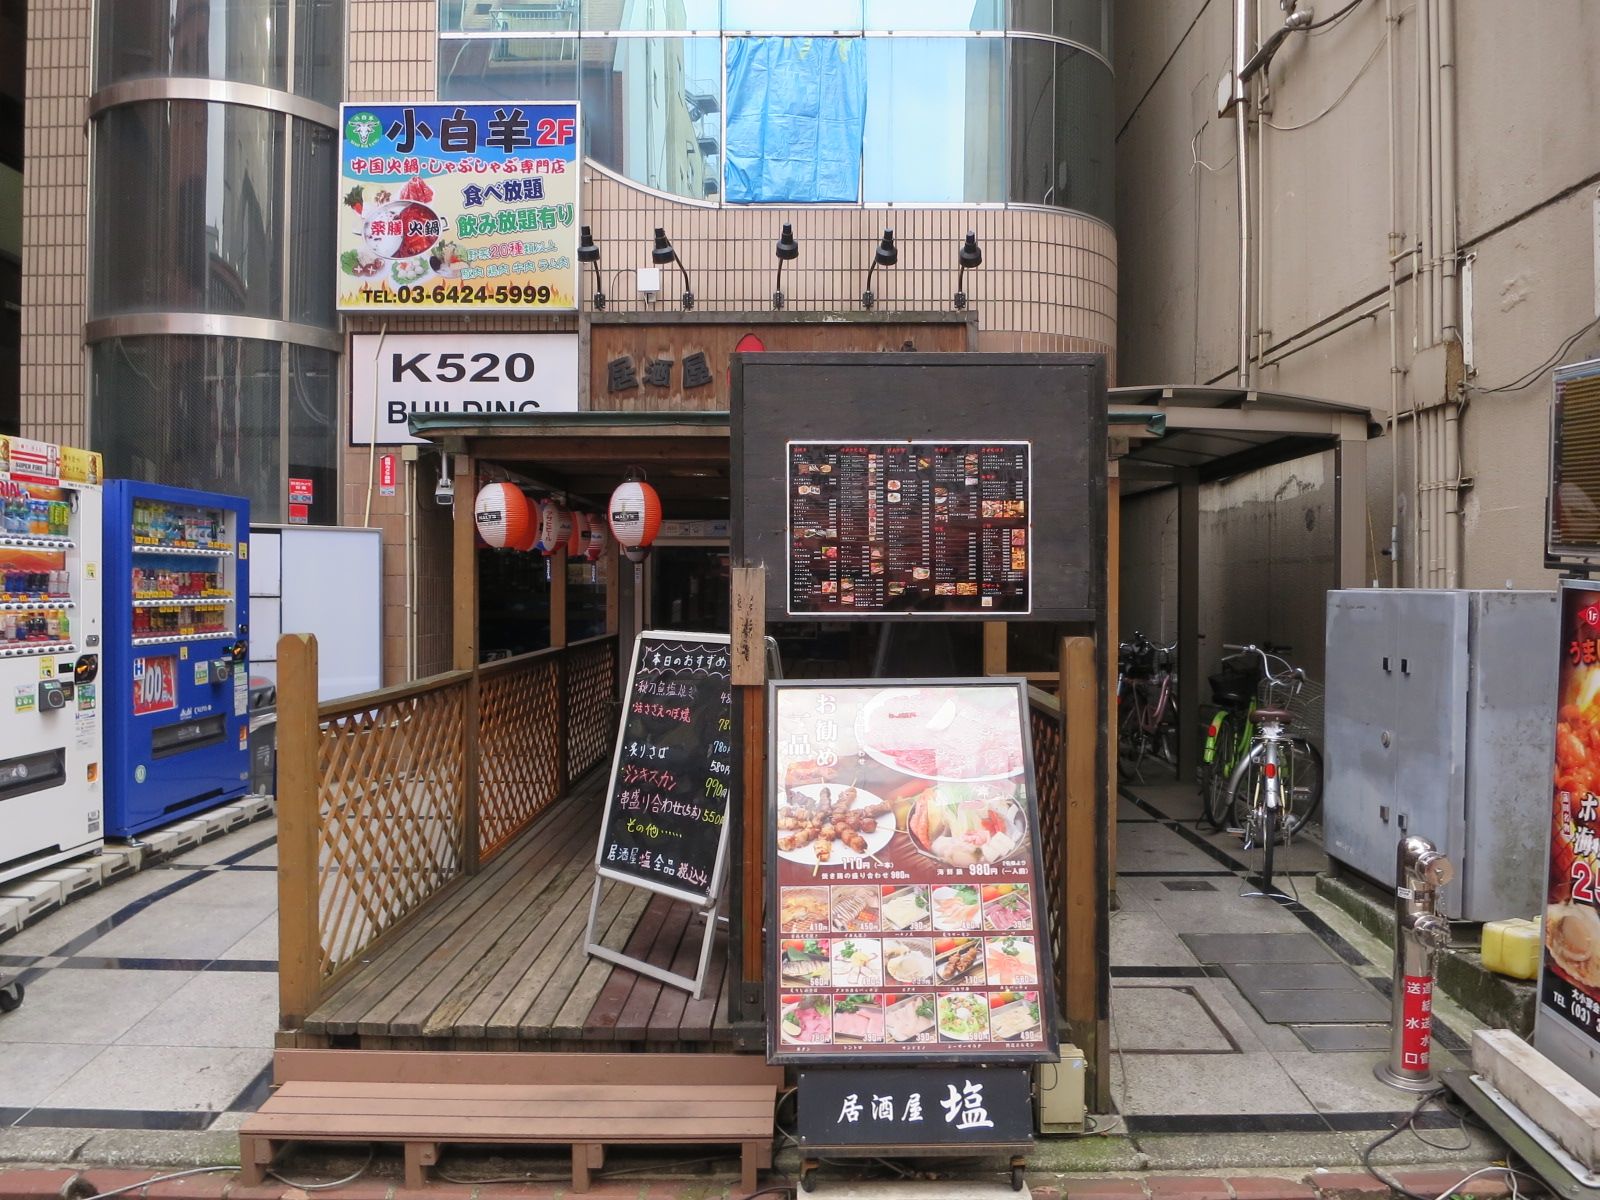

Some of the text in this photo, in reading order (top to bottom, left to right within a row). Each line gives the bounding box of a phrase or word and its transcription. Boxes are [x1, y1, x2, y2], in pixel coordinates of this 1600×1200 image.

[384, 108, 575, 153] 小白羊 2F
[351, 158, 566, 174] 中国火鍋・しゃぶしゃぶ専門店
[462, 177, 544, 208] 食べ放題
[370, 220, 441, 236] 薬膳 火鍋
[457, 203, 575, 239] 飲み放題有り
[392, 353, 535, 383] K520
[607, 351, 713, 393] 居酒屋
[1588, 610, 1598, 622] 1F
[652, 653, 727, 668] 本日のおすすめ
[1570, 639, 1600, 665] うま
[718, 718, 731, 732] 78
[629, 742, 669, 760] 炙りさば
[841, 857, 870, 870] 110円
[969, 863, 998, 876] 980円
[1553, 991, 1590, 1025] TEL (03)
[1404, 980, 1422, 1065] 送水口
[836, 1079, 994, 1130] 居酒屋 塩
